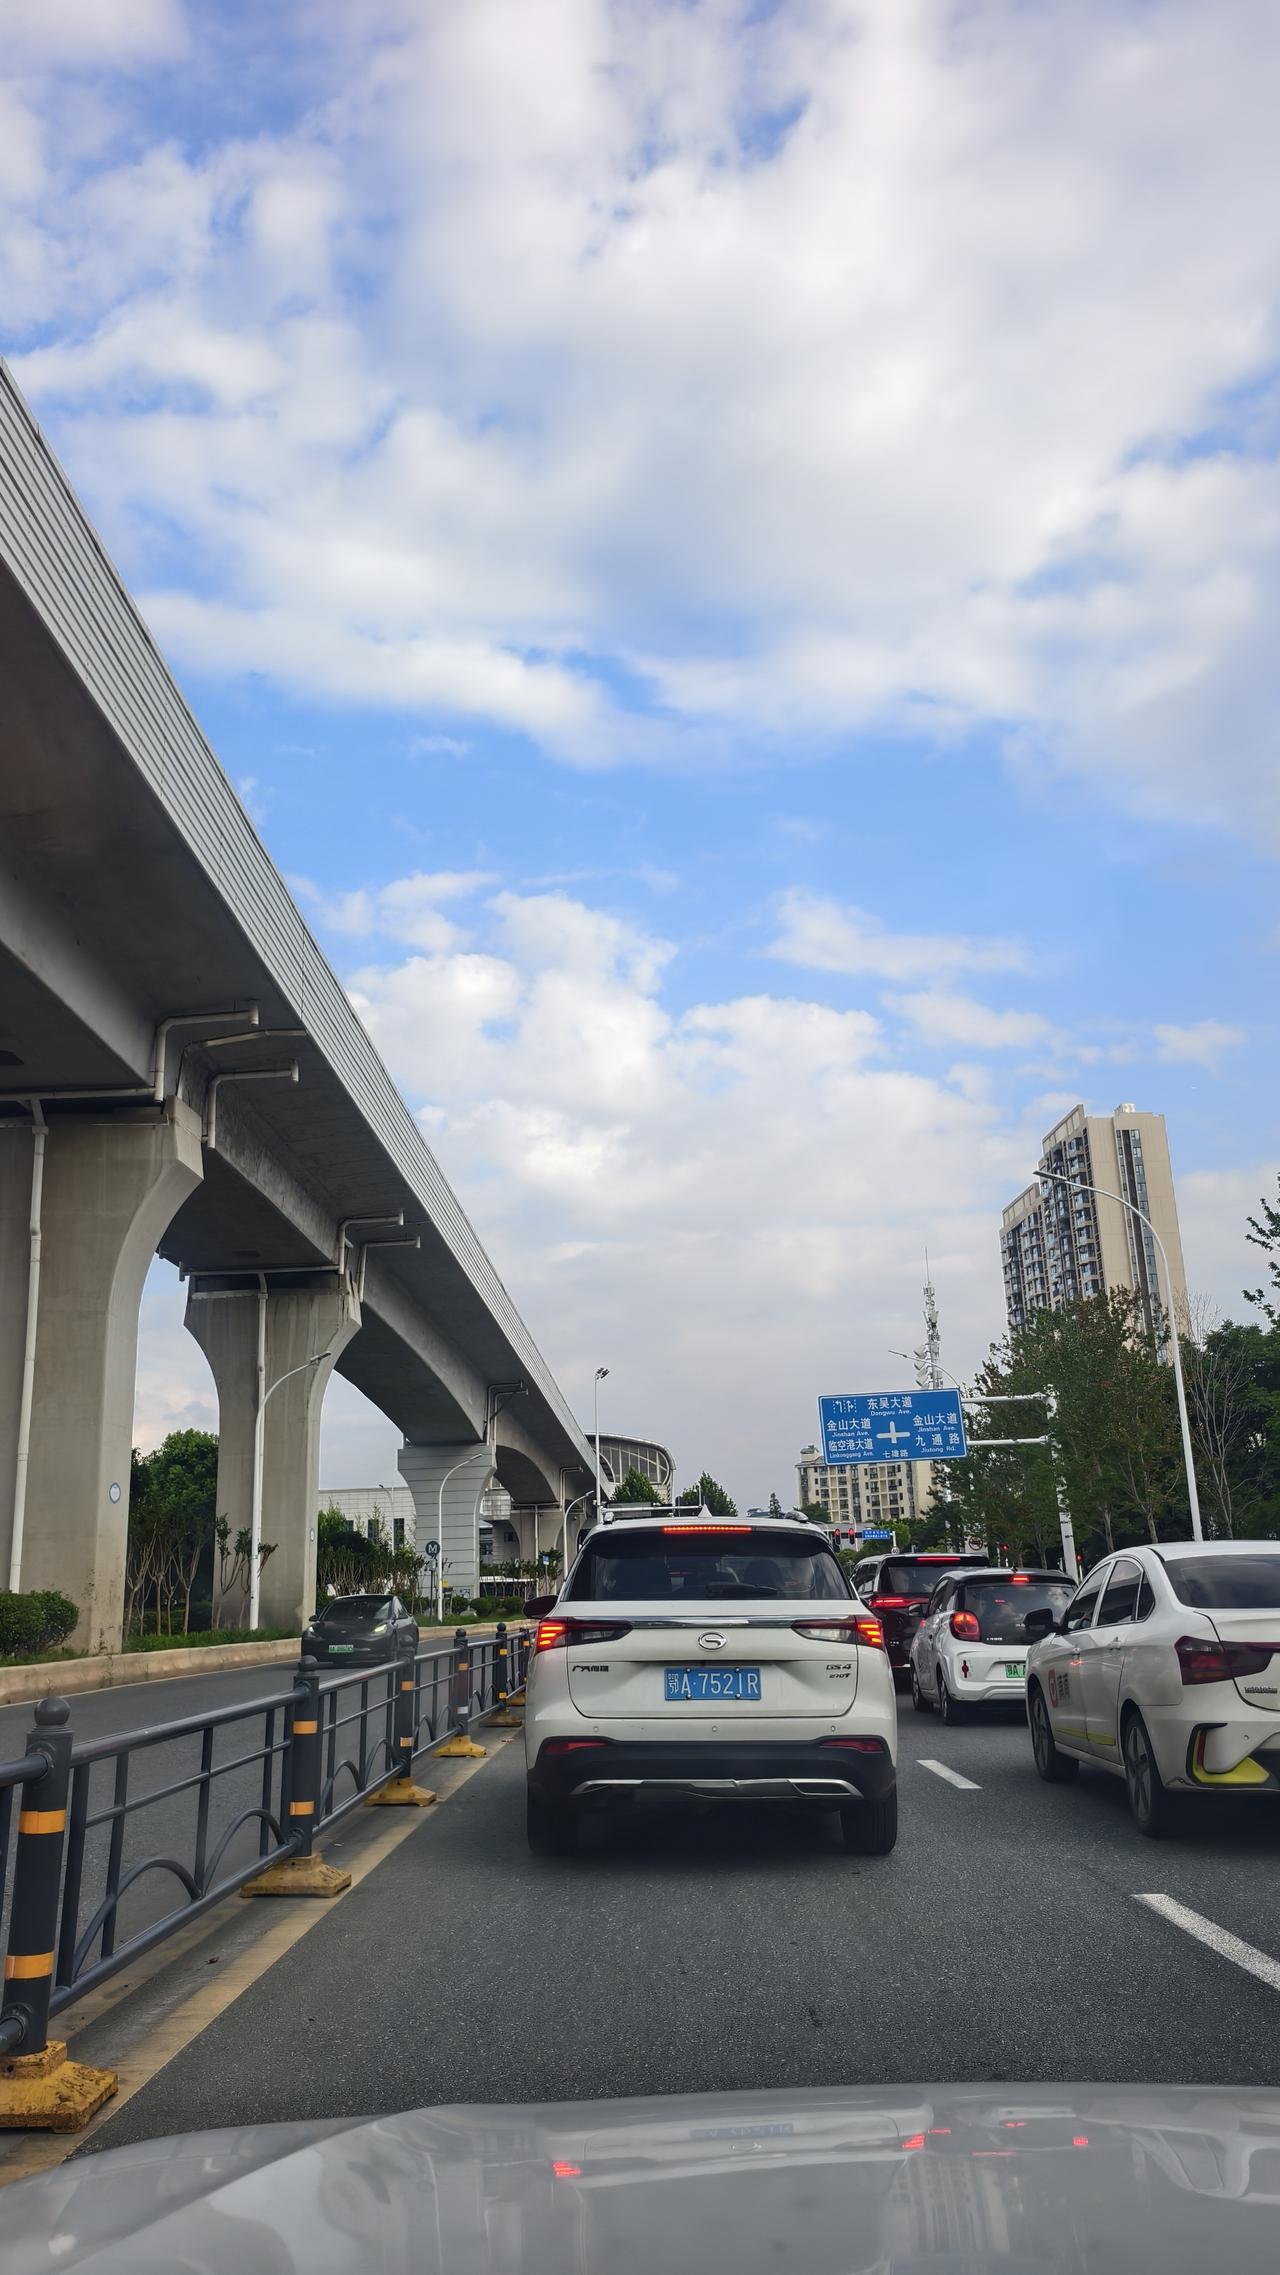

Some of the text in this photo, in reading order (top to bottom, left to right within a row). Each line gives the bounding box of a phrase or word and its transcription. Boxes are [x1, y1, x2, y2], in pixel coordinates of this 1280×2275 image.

[866, 1396, 913, 1410] 东吴大道
[826, 1417, 872, 1431] 金山大道
[912, 1412, 958, 1426] 金山大道
[828, 1438, 874, 1452] 临空港大道
